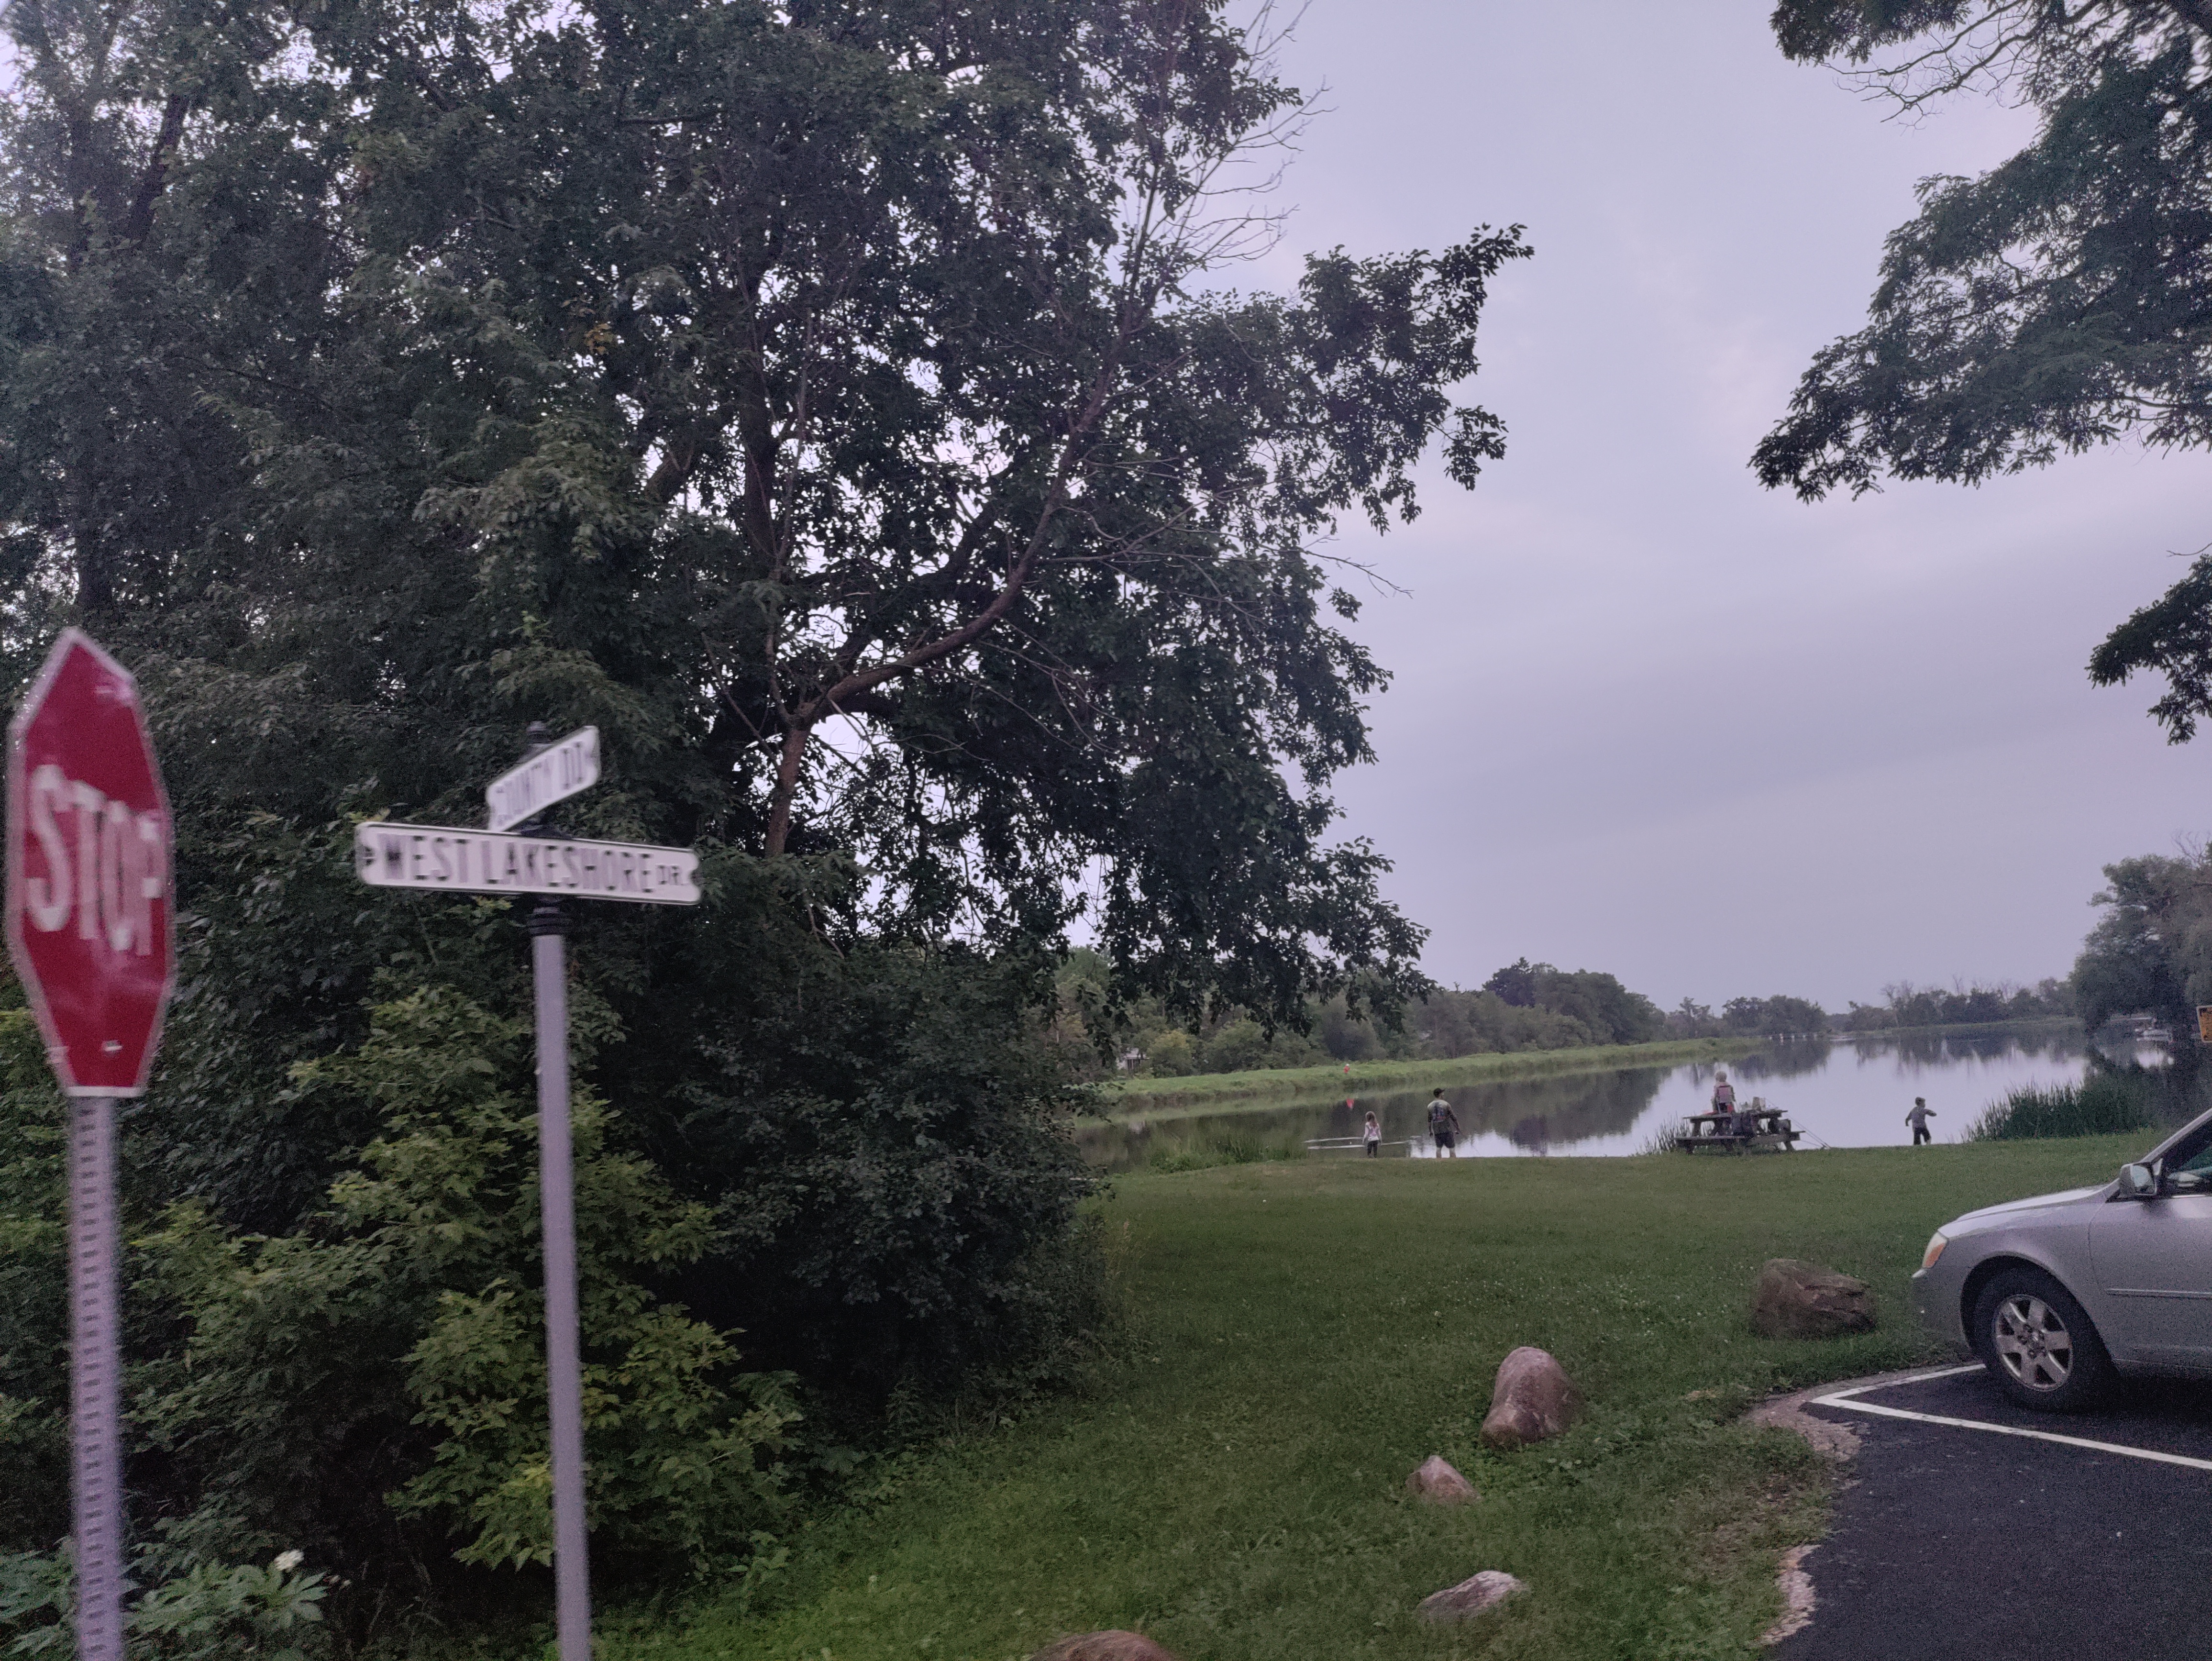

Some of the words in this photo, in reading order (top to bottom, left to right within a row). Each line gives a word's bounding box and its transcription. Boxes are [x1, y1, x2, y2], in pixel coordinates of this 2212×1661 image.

[24, 764, 167, 956] STOP
[377, 833, 472, 883] WEST
[479, 840, 655, 893] LAKESHORE
[655, 864, 687, 886] DR
